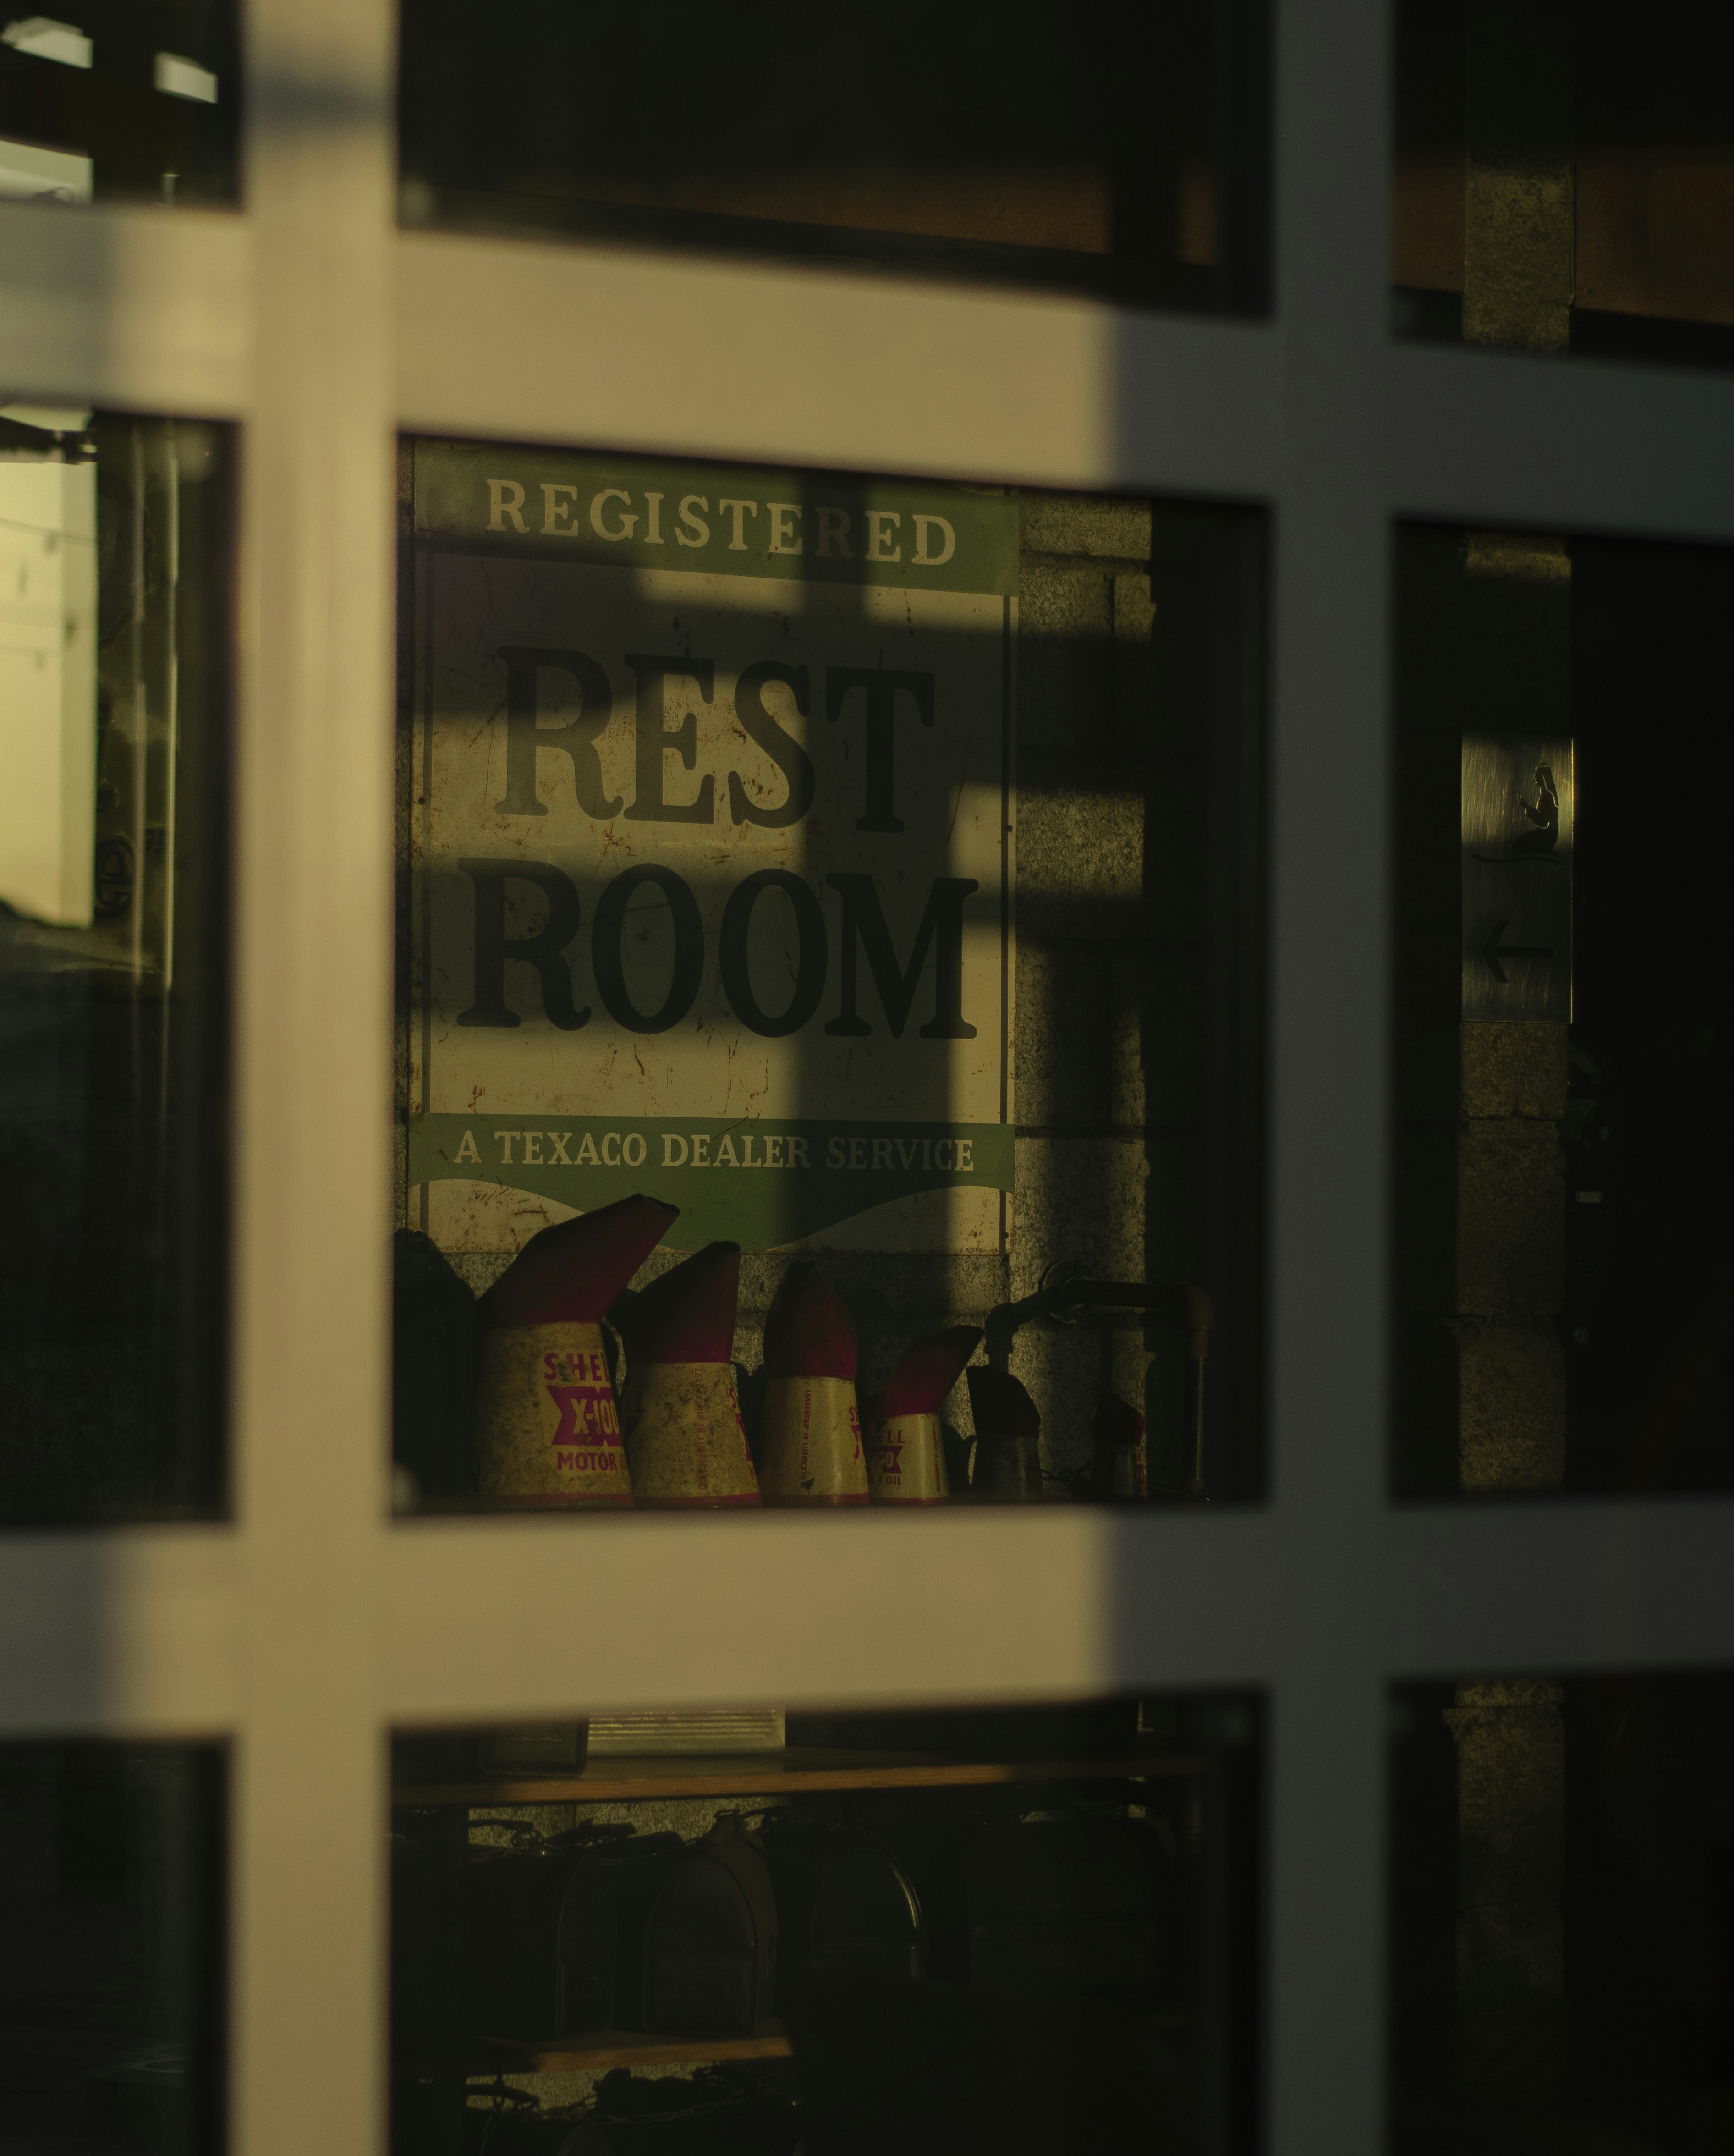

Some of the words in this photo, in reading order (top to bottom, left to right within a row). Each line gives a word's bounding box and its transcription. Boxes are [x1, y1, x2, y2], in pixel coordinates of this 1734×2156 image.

[486, 478, 957, 566] REGISTERED
[494, 645, 935, 834] REST
[457, 857, 979, 1040] ROOM
[453, 1129, 483, 1165] A
[494, 1130, 648, 1167] TEXACO
[660, 1133, 812, 1168] DEALER
[826, 1137, 975, 1172] SERVICE
[557, 1452, 617, 1471] MOTOR
[886, 1476, 903, 1485] OIL
